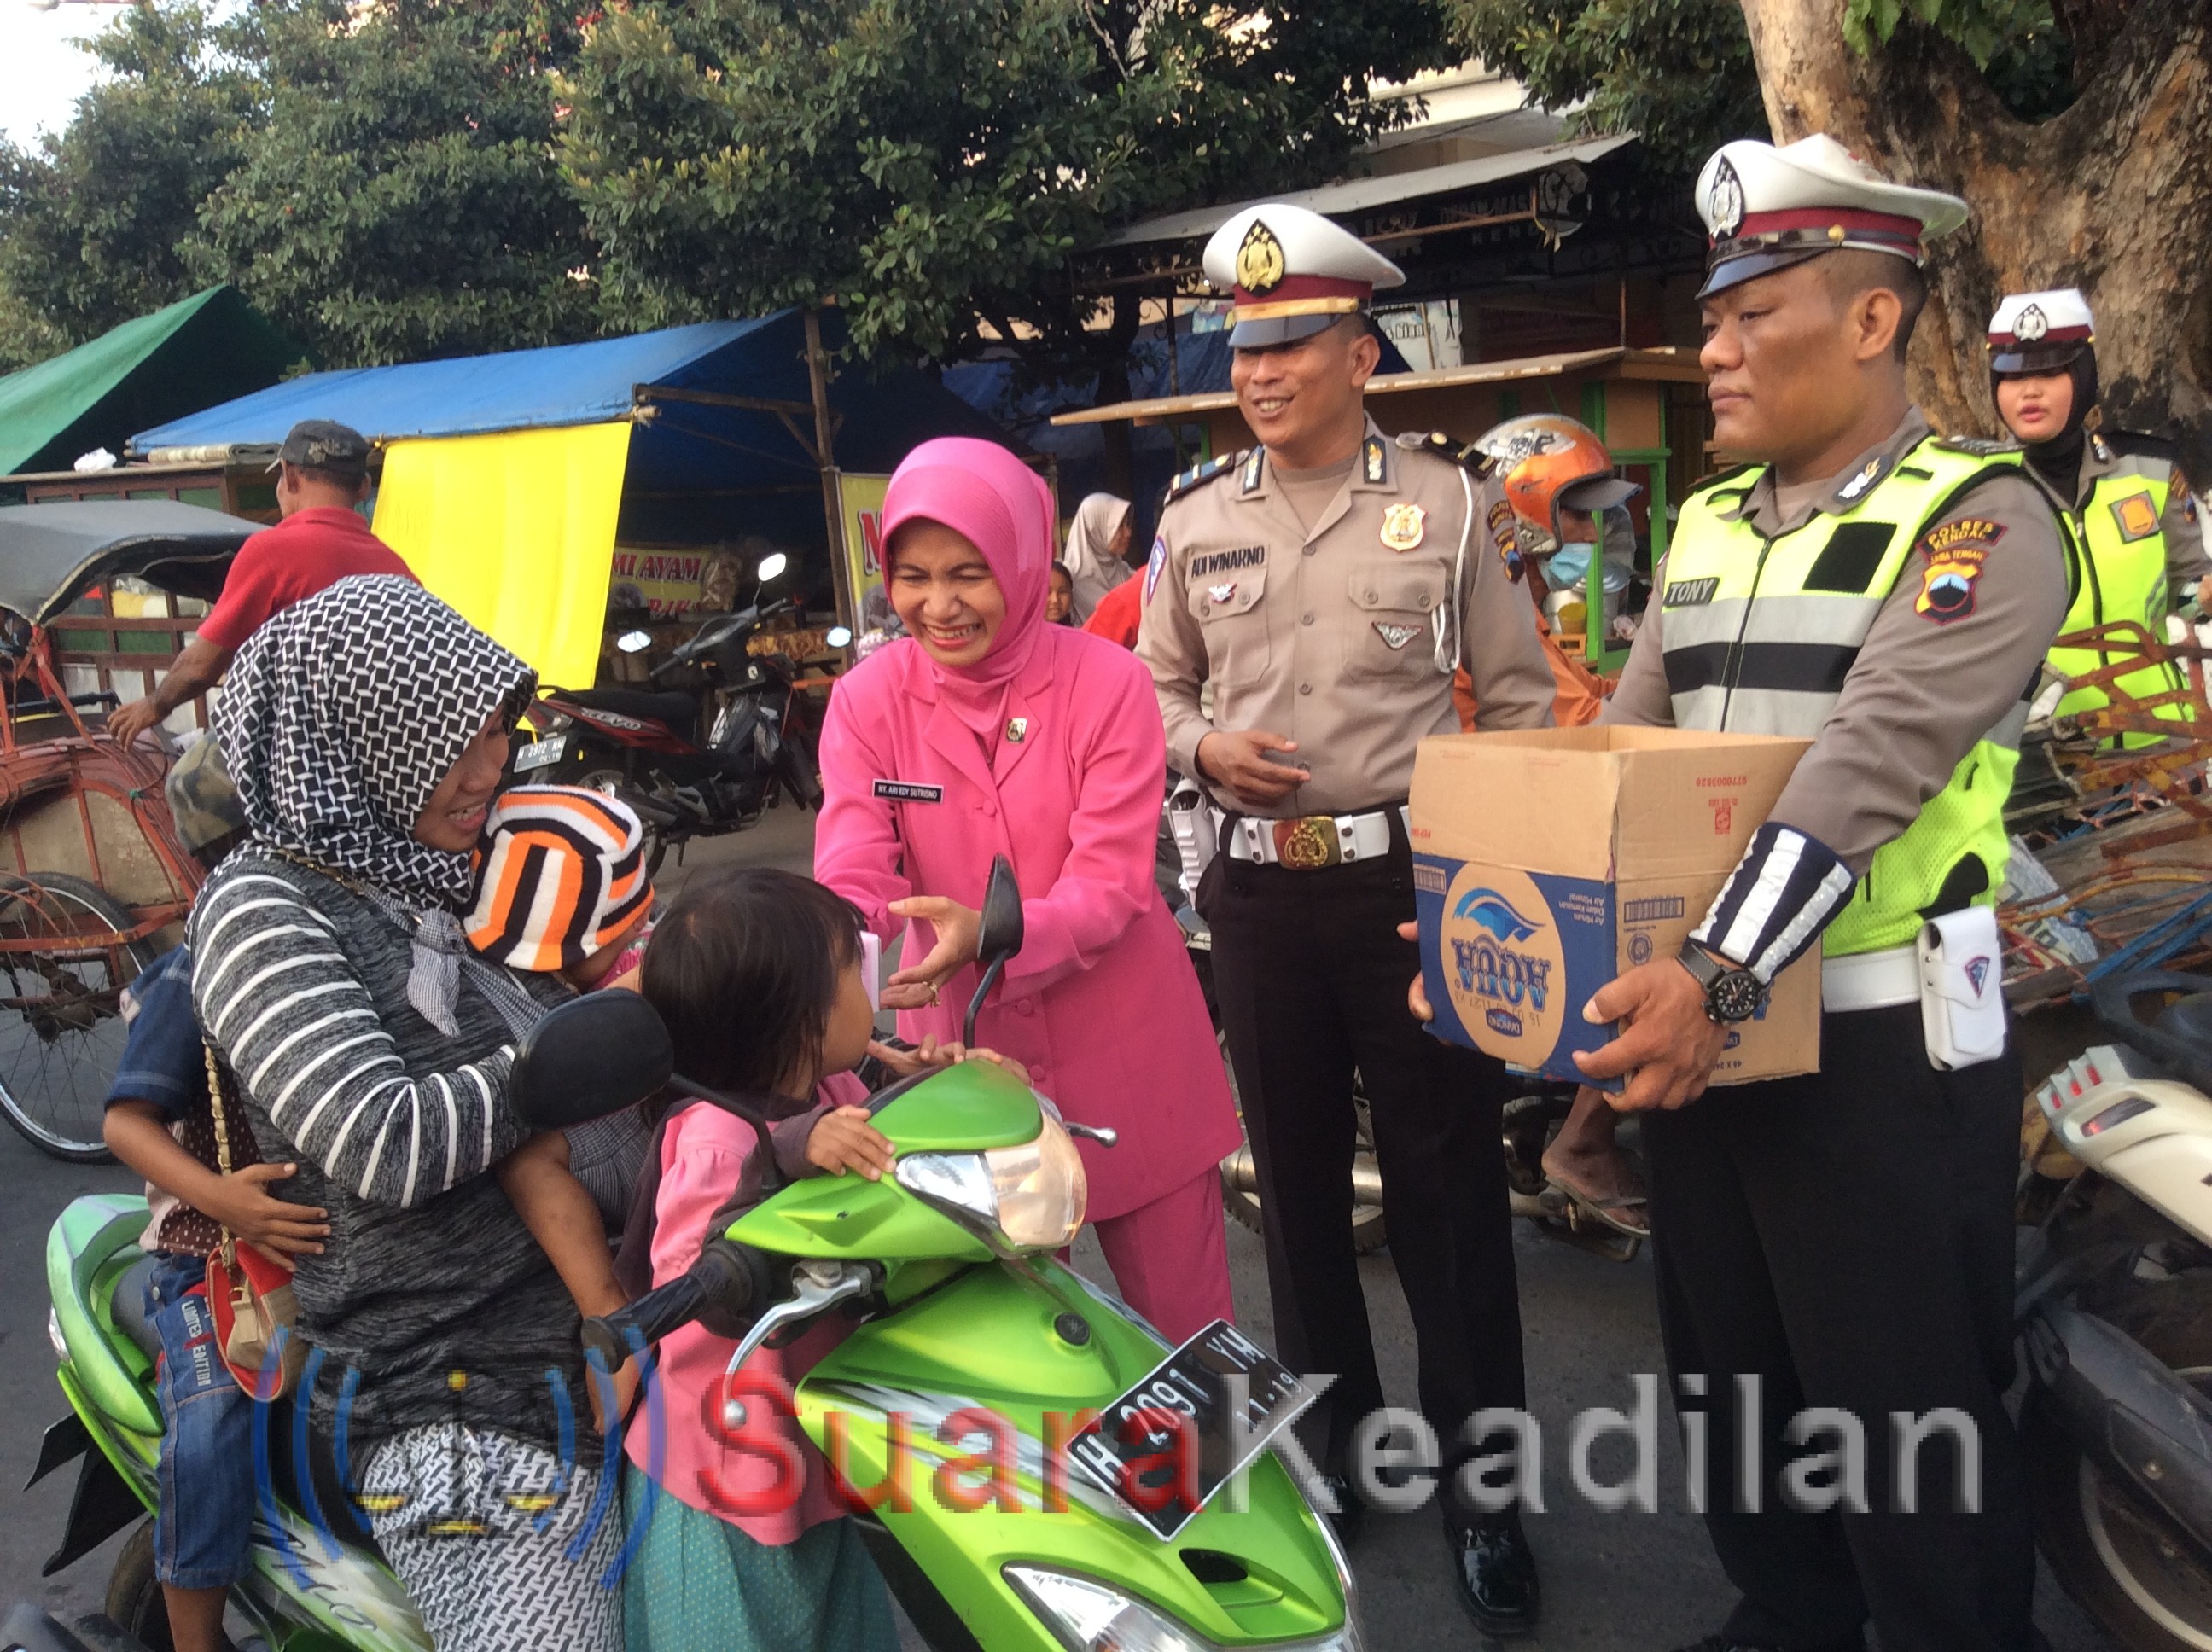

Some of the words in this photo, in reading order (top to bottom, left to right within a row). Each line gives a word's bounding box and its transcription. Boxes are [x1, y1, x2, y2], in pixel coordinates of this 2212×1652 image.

[1928, 521, 1994, 545] POLRES
[1932, 528, 1987, 550] KENDAL
[638, 555, 701, 581] AYAM
[1209, 545, 1265, 573] WINARNO
[1668, 578, 1715, 603] TONY
[1487, 1014, 1521, 1035] DANONE
[182, 1300, 203, 1339] LIMITED
[193, 1344, 212, 1387] EDITION
[1077, 1434, 1132, 1486] H
[1120, 1367, 1213, 1447] 2091
